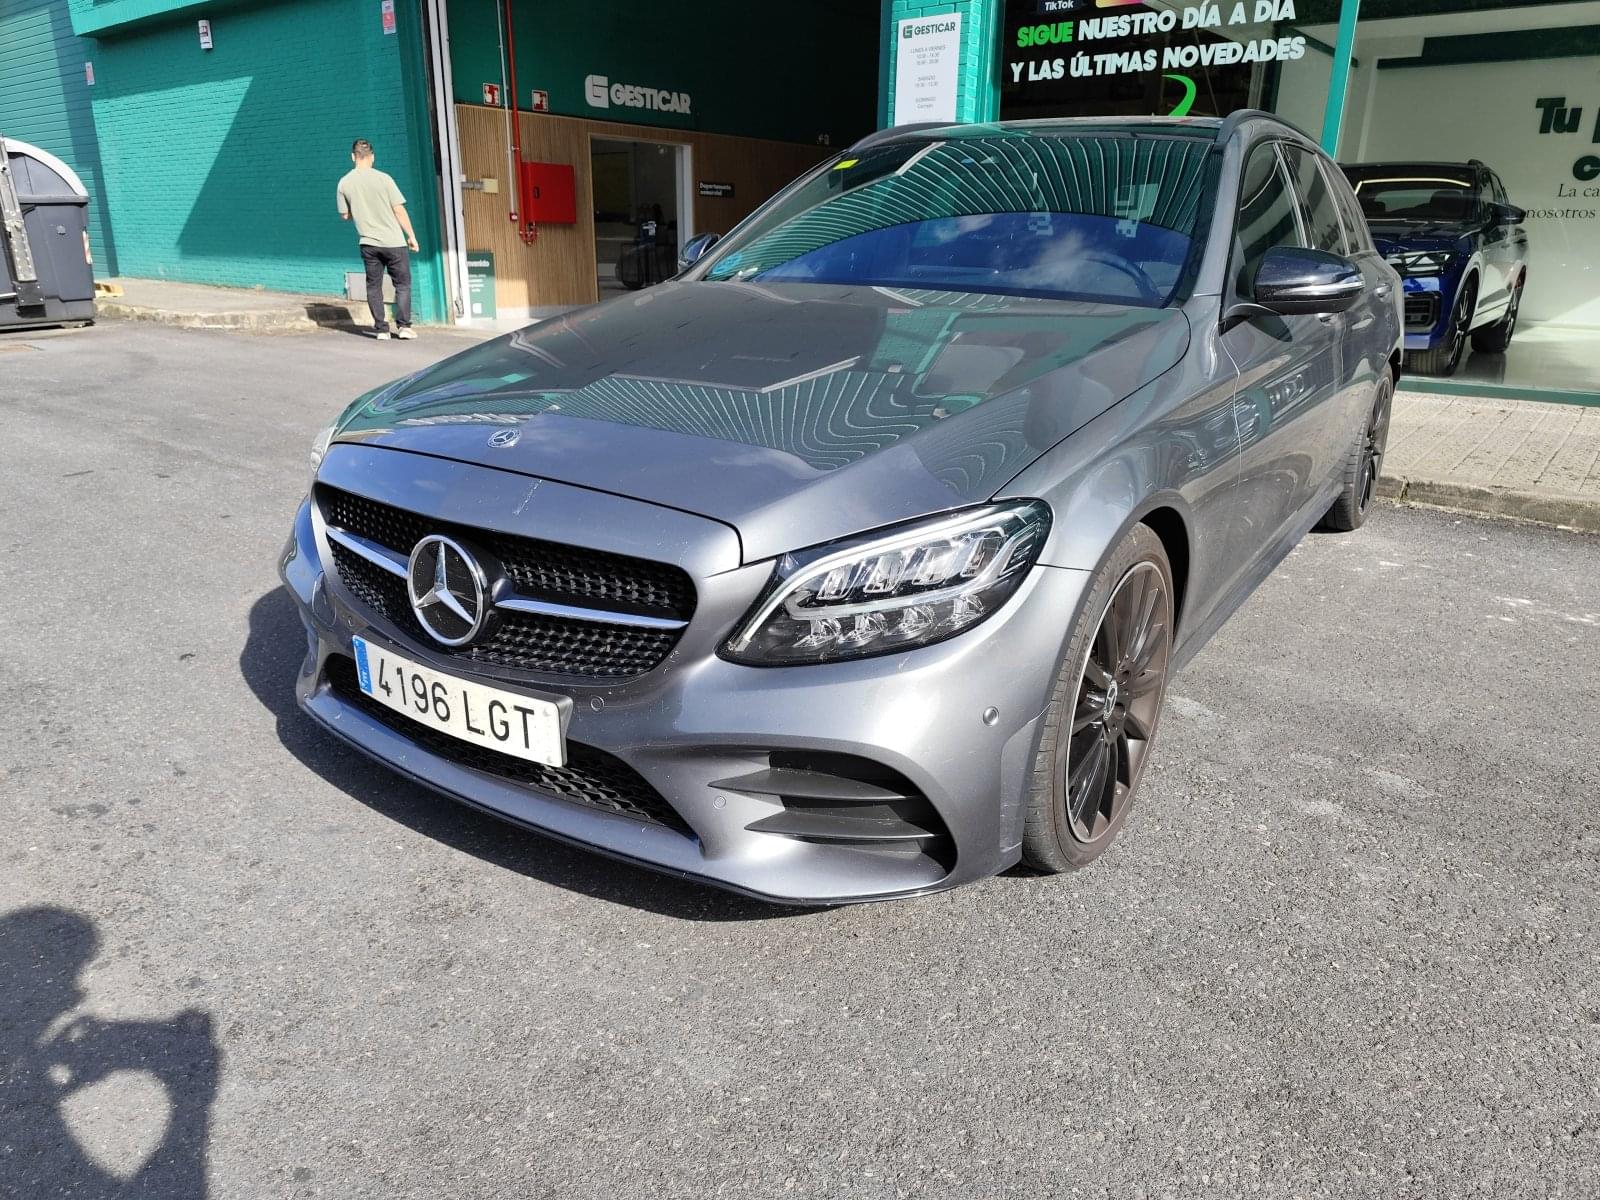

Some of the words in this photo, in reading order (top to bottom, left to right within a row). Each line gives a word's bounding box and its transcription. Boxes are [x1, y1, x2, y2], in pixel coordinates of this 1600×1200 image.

[1045, 0, 1074, 11] TikTok
[914, 21, 956, 35] GESTICAR
[1017, 21, 1074, 48] SIGUE
[1078, 9, 1177, 41] NUESTRO
[1182, 0, 1222, 30] DÍA
[1228, 2, 1247, 25] A
[1010, 62, 1025, 83] Y
[1028, 58, 1065, 81] LAS
[1069, 48, 1158, 78] ÚLTIMAS
[1161, 36, 1306, 69] NOVEDADES
[610, 82, 691, 115] GESTICAR
[1535, 96, 1583, 134] Tu
[1557, 183, 1577, 198] La
[1526, 207, 1596, 220] nosotros
[378, 658, 451, 722] 4196
[463, 690, 535, 749] LGT
